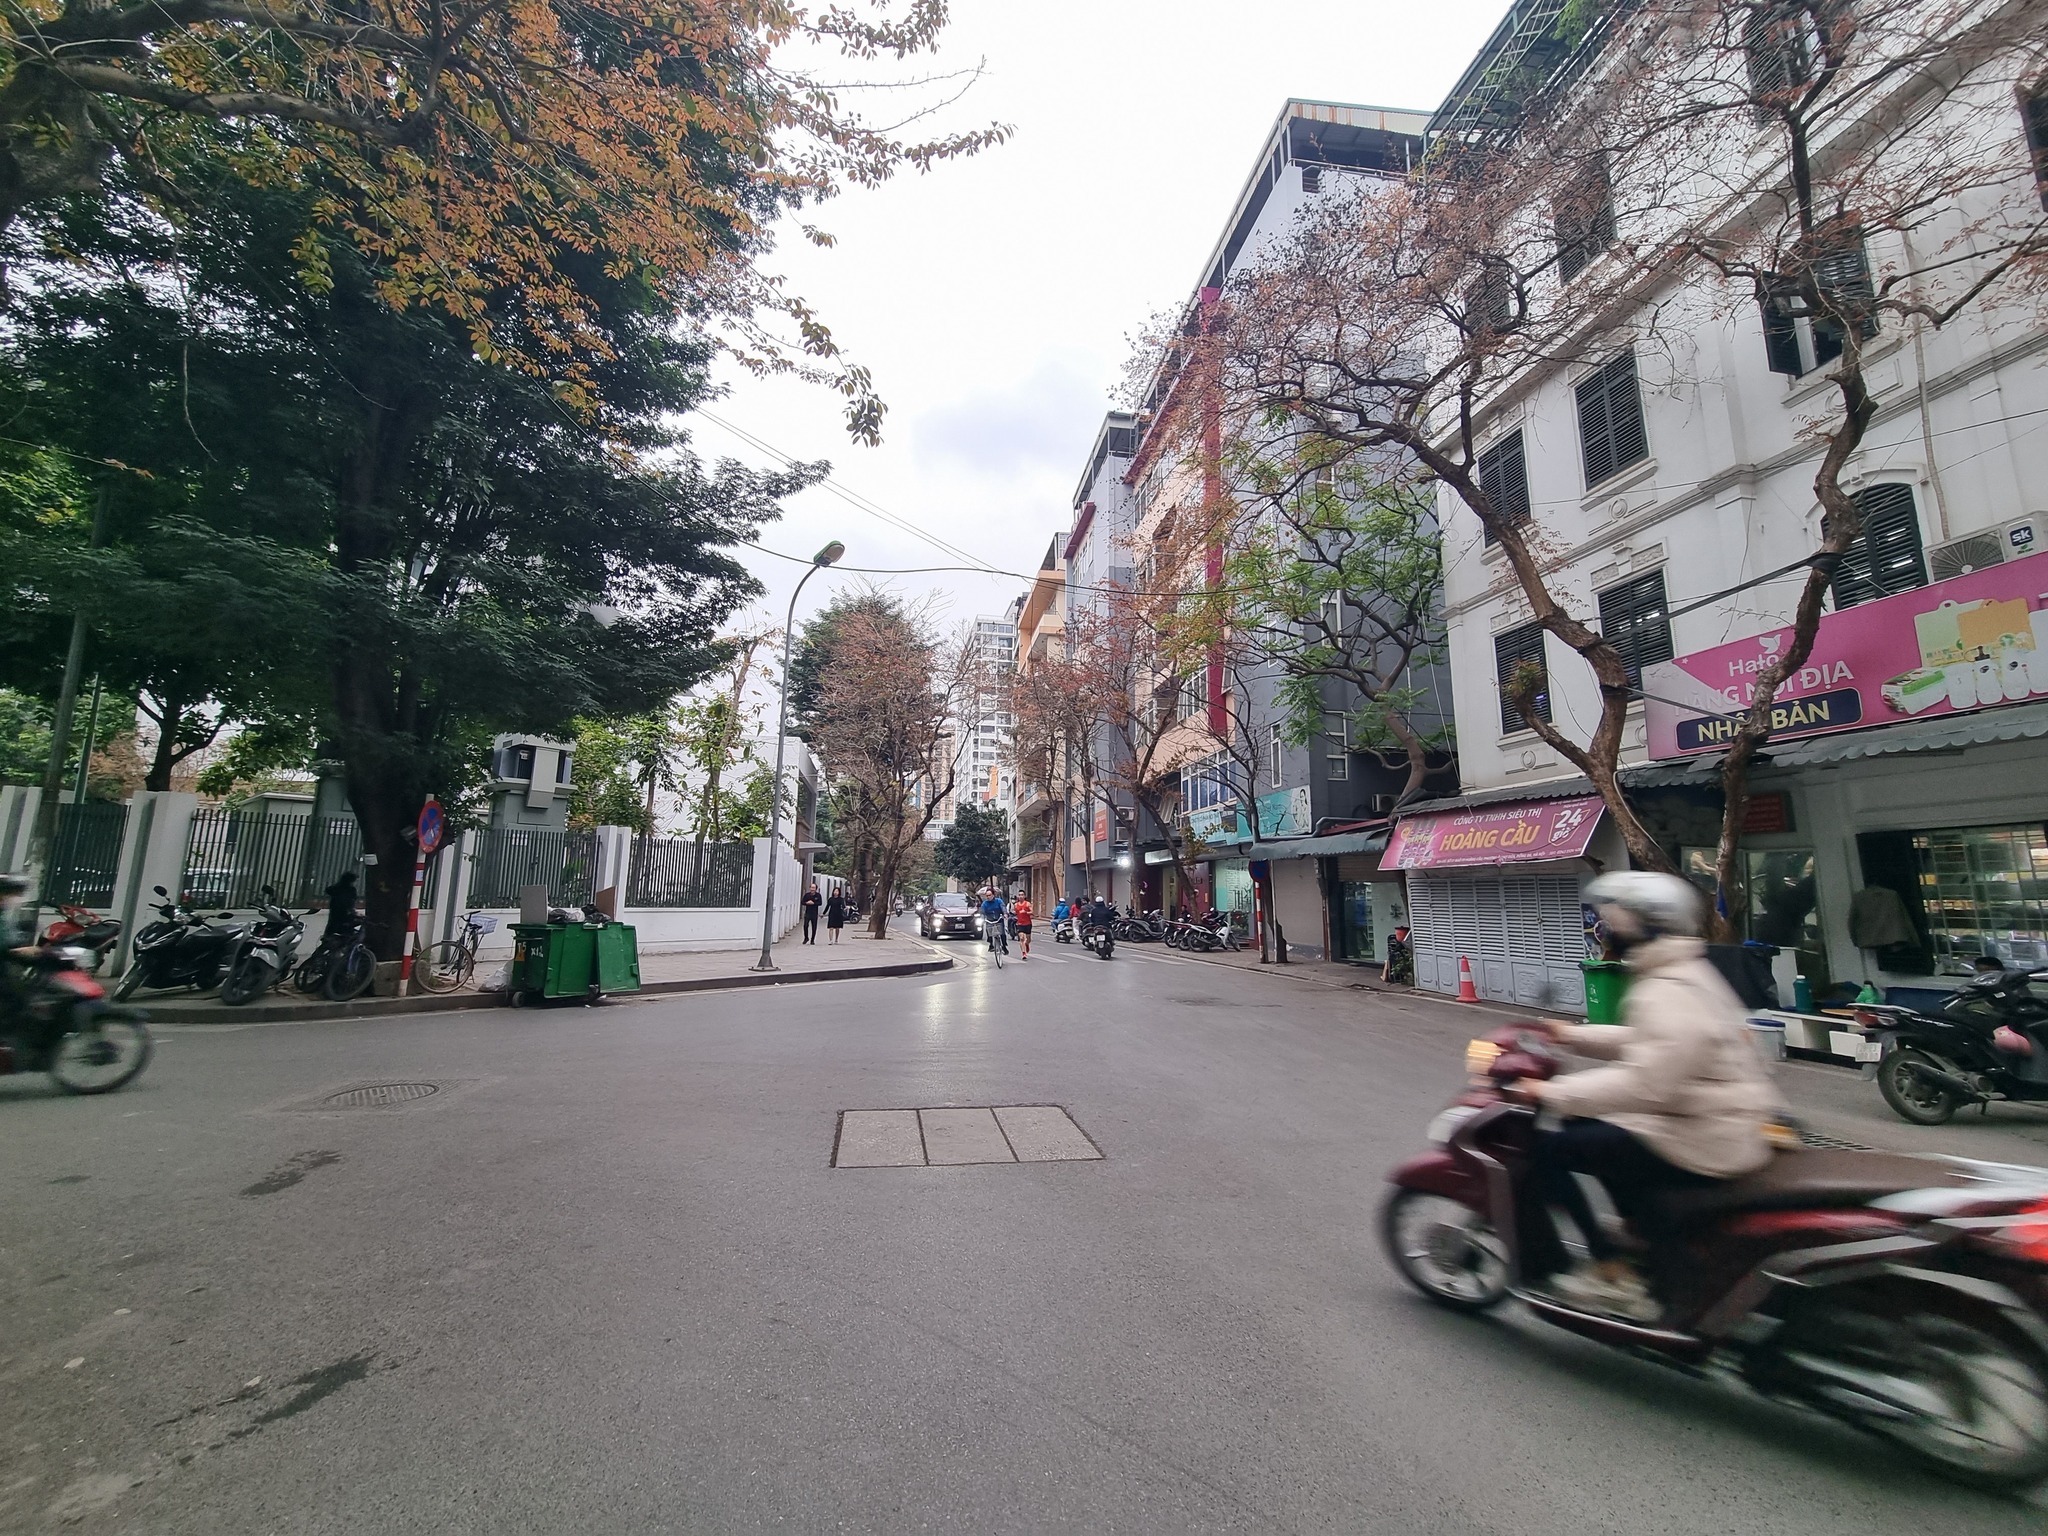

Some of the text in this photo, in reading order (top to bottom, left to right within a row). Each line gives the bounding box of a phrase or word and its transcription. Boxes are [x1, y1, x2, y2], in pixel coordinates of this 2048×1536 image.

[1728, 654, 1779, 677] Hato
[1800, 661, 1855, 689] ĐỊA
[1771, 700, 1830, 729] BẢN
[1453, 808, 1543, 826] CÔNG TY TNHH SIÊU THỊ
[1555, 808, 1582, 829] 24
[1439, 819, 1541, 851] HOÀNG CẦU
